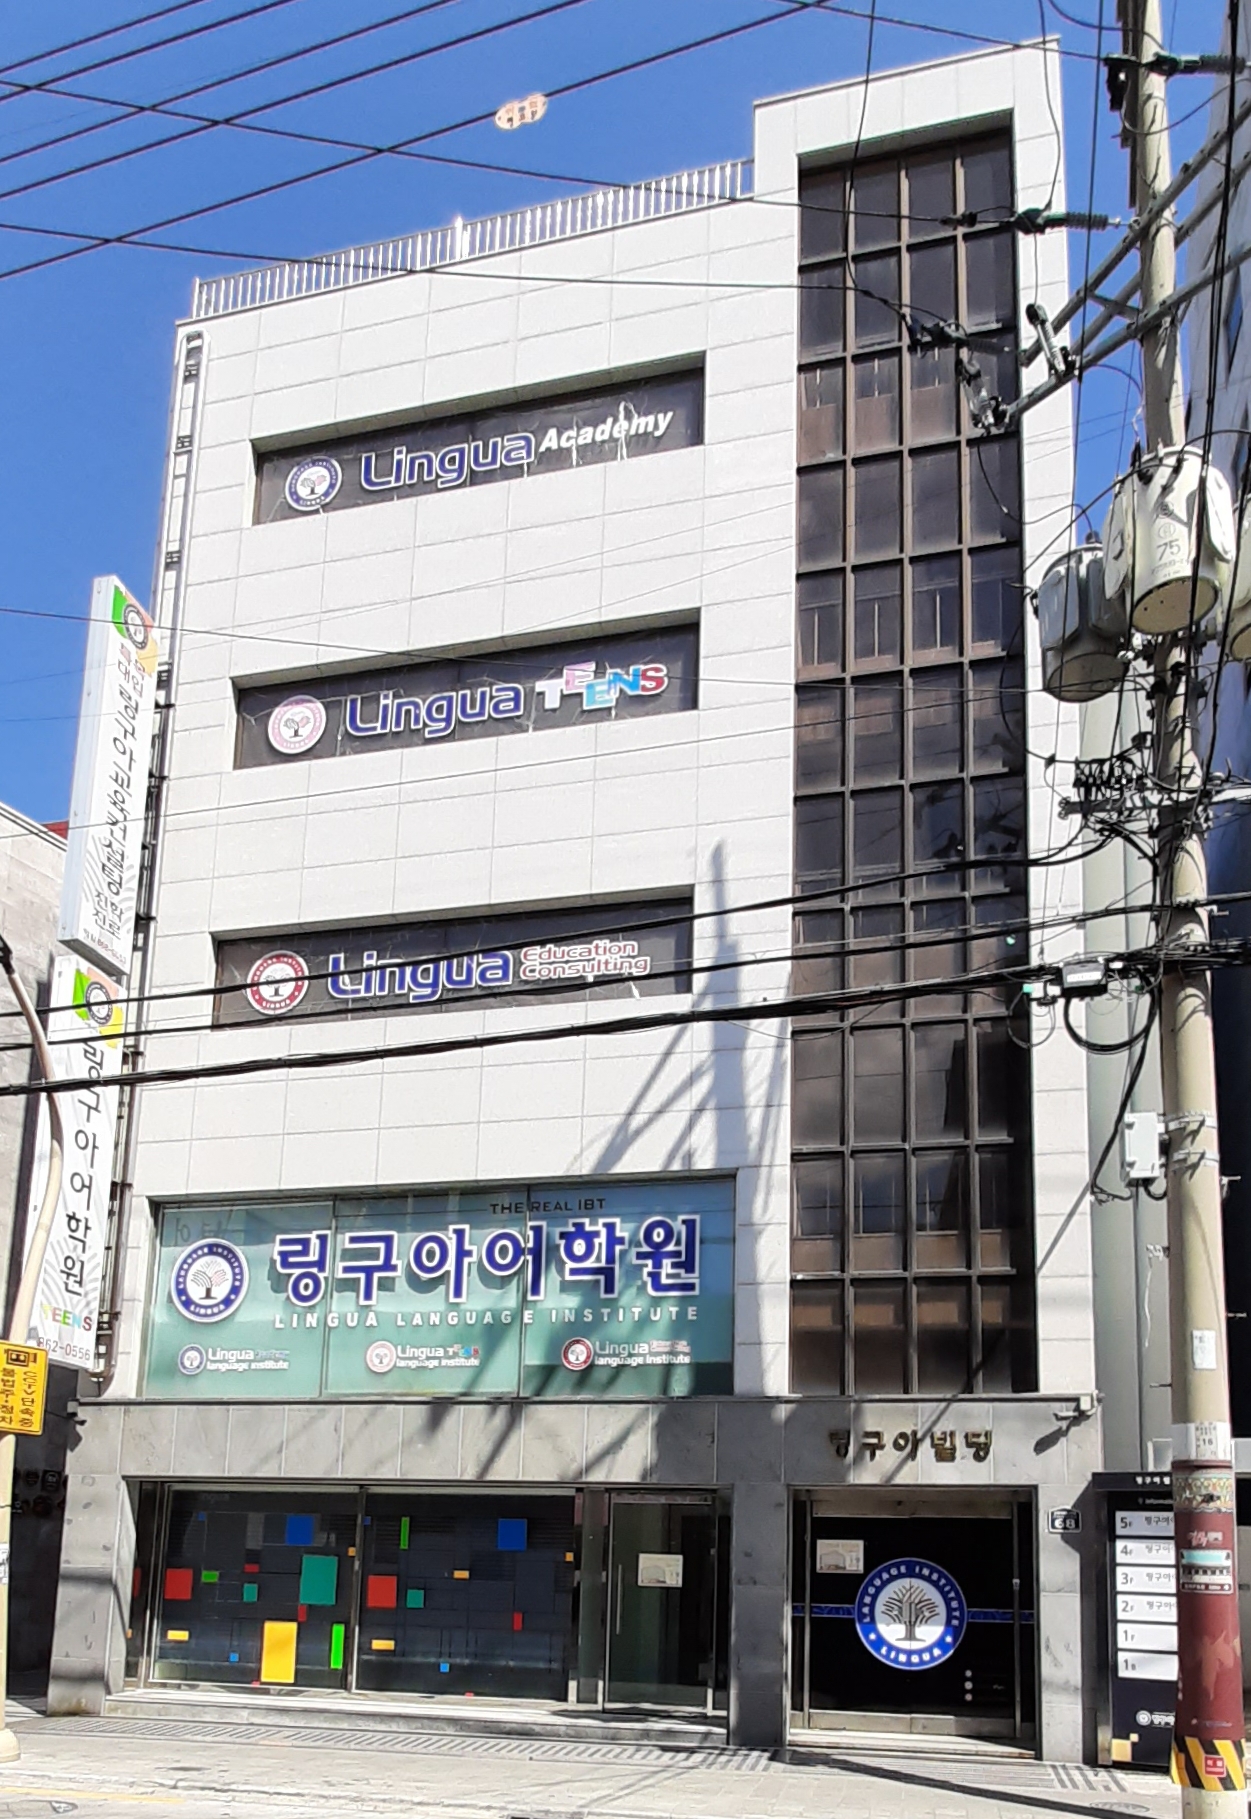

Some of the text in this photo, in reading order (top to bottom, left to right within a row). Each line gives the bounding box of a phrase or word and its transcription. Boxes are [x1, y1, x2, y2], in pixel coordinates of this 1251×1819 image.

[361, 432, 535, 491] Lingua
[539, 410, 673, 453] Academy
[1156, 538, 1181, 561] 75
[345, 684, 524, 739] Lingua
[535, 662, 668, 711] TEENS
[521, 939, 638, 962] Education
[328, 950, 514, 1003] Lingua
[520, 956, 650, 979] Consulting
[60, 1040, 104, 1297] 링구아어학원
[490, 1198, 606, 1214] THE REAL IBT
[274, 1214, 701, 1306] 링구아어학원
[42, 1303, 93, 1331] TEENS
[274, 1307, 698, 1329] LINGUA LANGUAGE INSTITUTE
[207, 1348, 254, 1362] Lingua
[397, 1345, 444, 1359] Lingua
[594, 1340, 649, 1357] Lingua
[829, 1429, 992, 1463] 링구아빌딩
[1054, 1518, 1076, 1529] 68
[862, 1565, 960, 1626] LANGUAGE INSTITUTE
[880, 1645, 942, 1663] LINGUA
